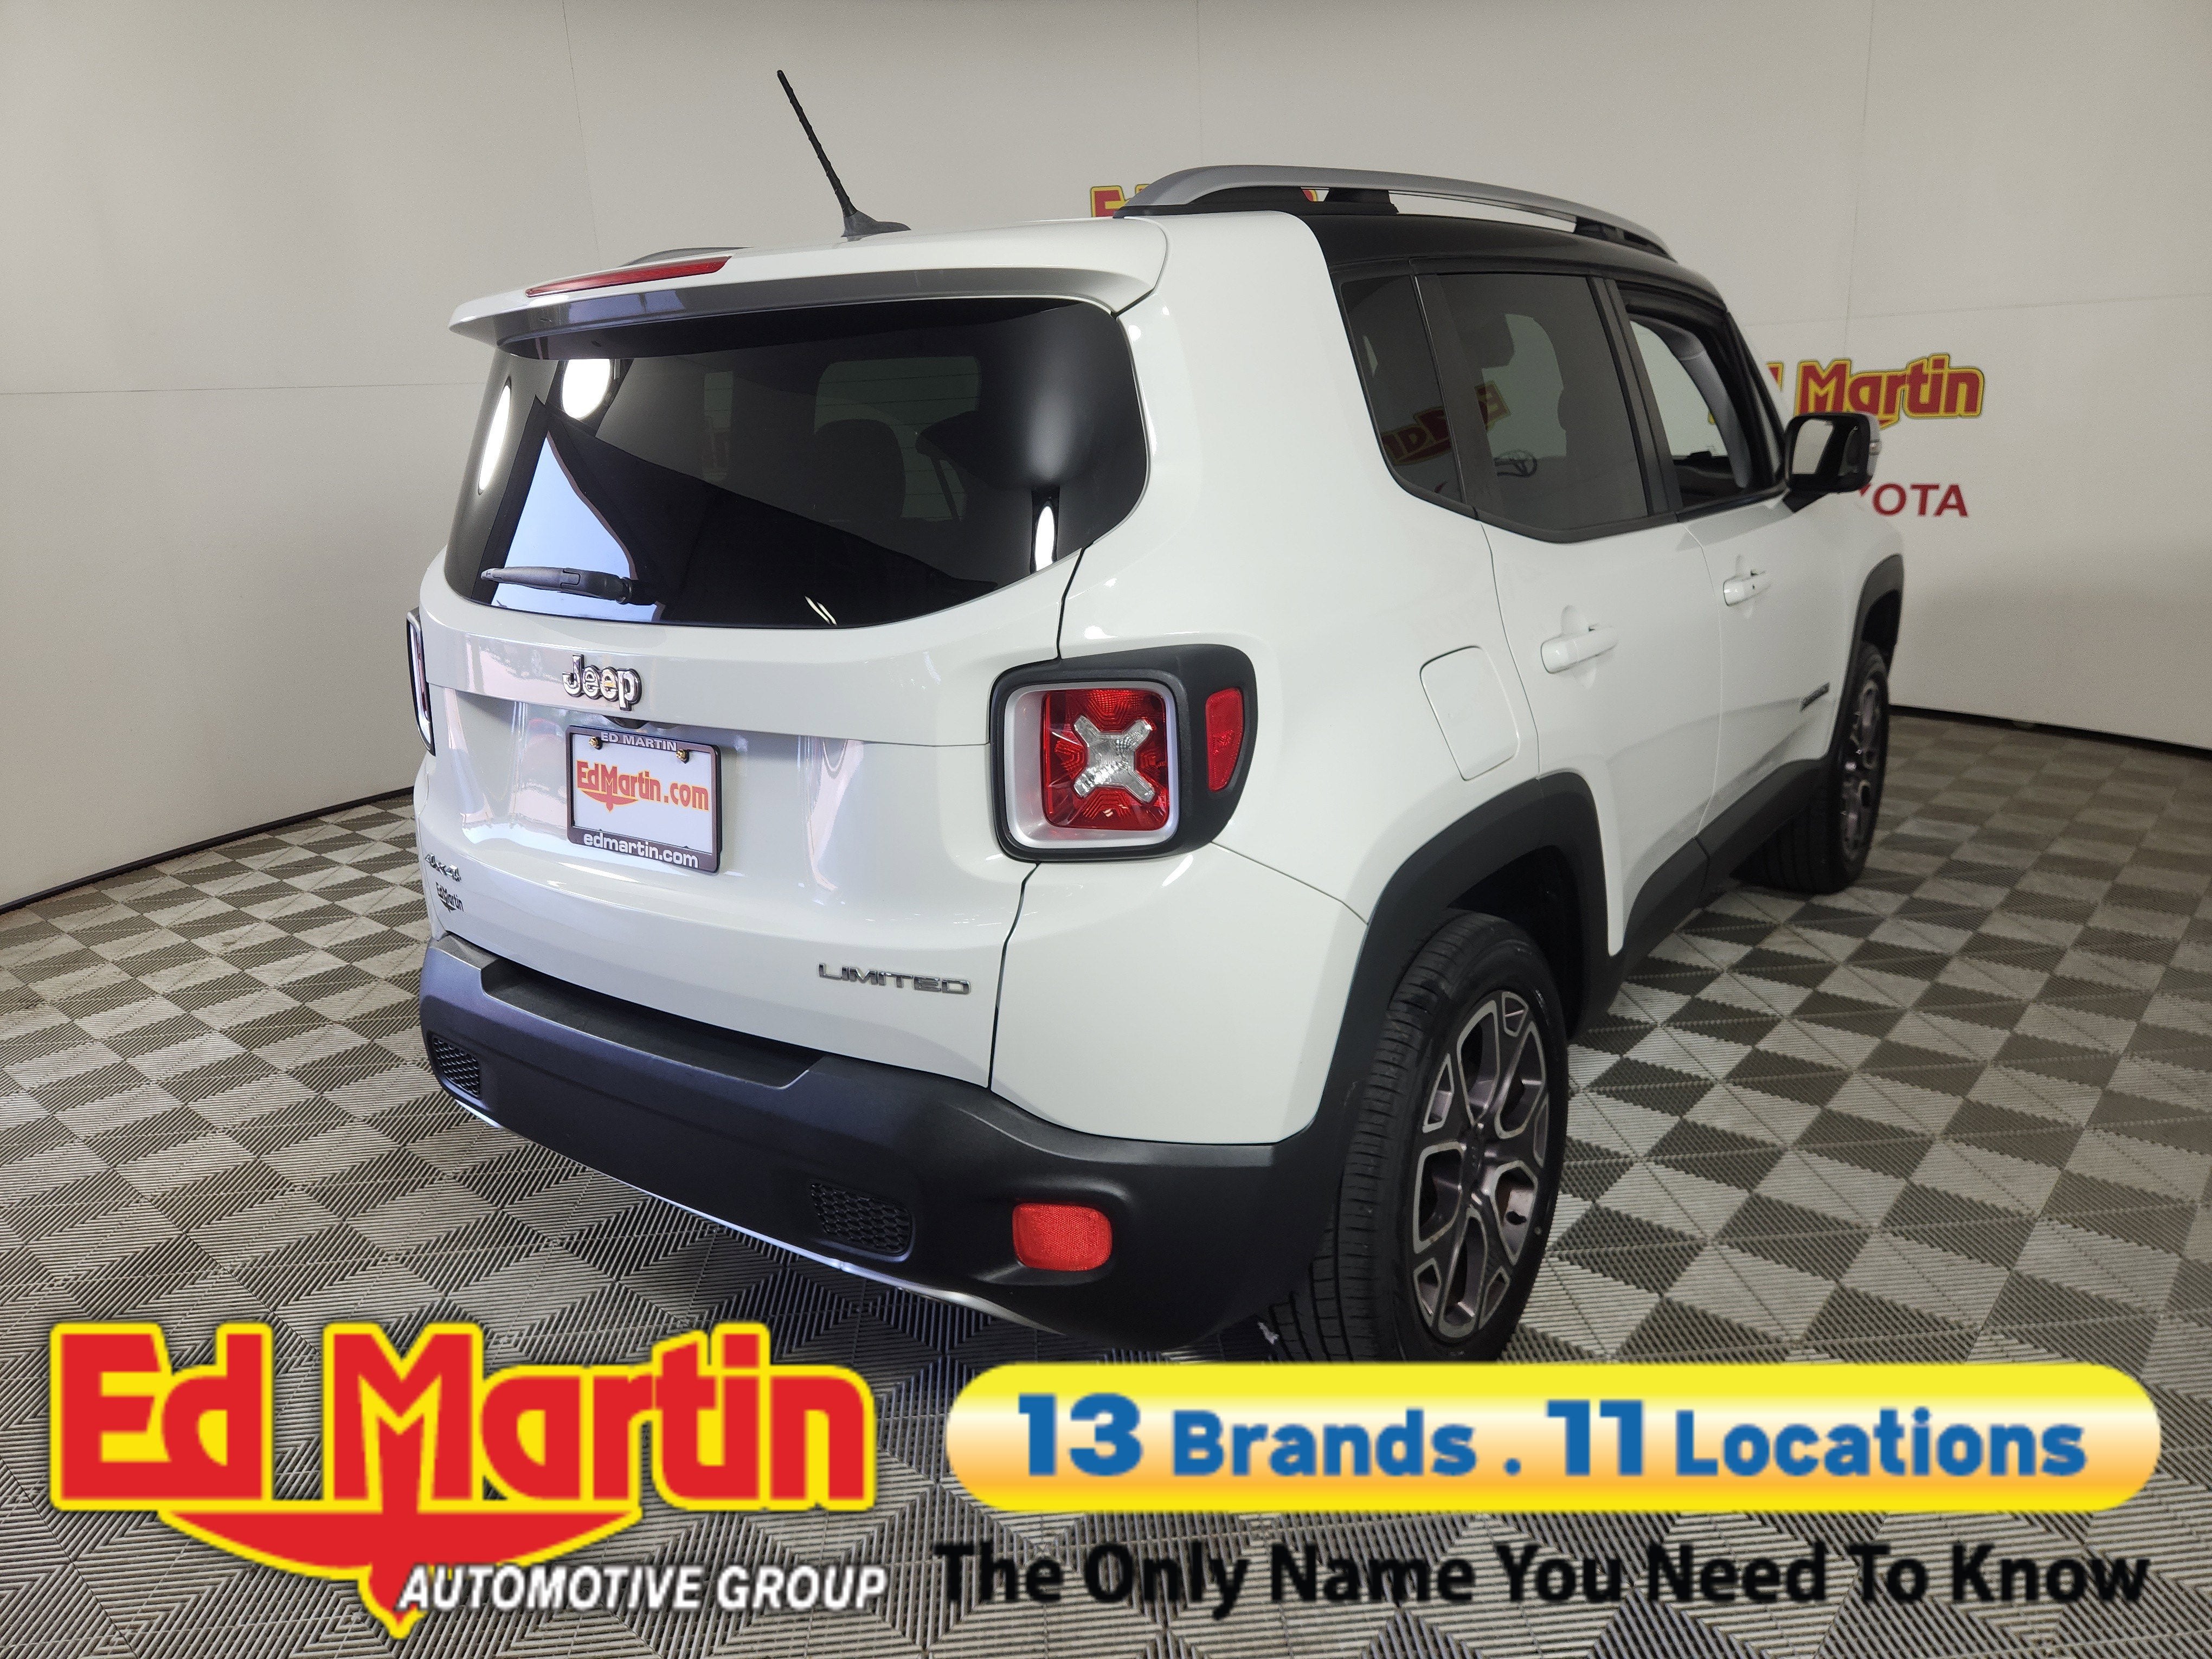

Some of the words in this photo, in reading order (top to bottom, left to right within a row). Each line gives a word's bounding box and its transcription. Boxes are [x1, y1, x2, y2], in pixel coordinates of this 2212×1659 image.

[1796, 353, 1984, 420] Martin
[562, 654, 642, 711] Jeep
[601, 732, 619, 743] ED
[623, 735, 677, 751] MARTIN
[583, 833, 699, 869] edmartin.com
[818, 962, 970, 995] LIMITED
